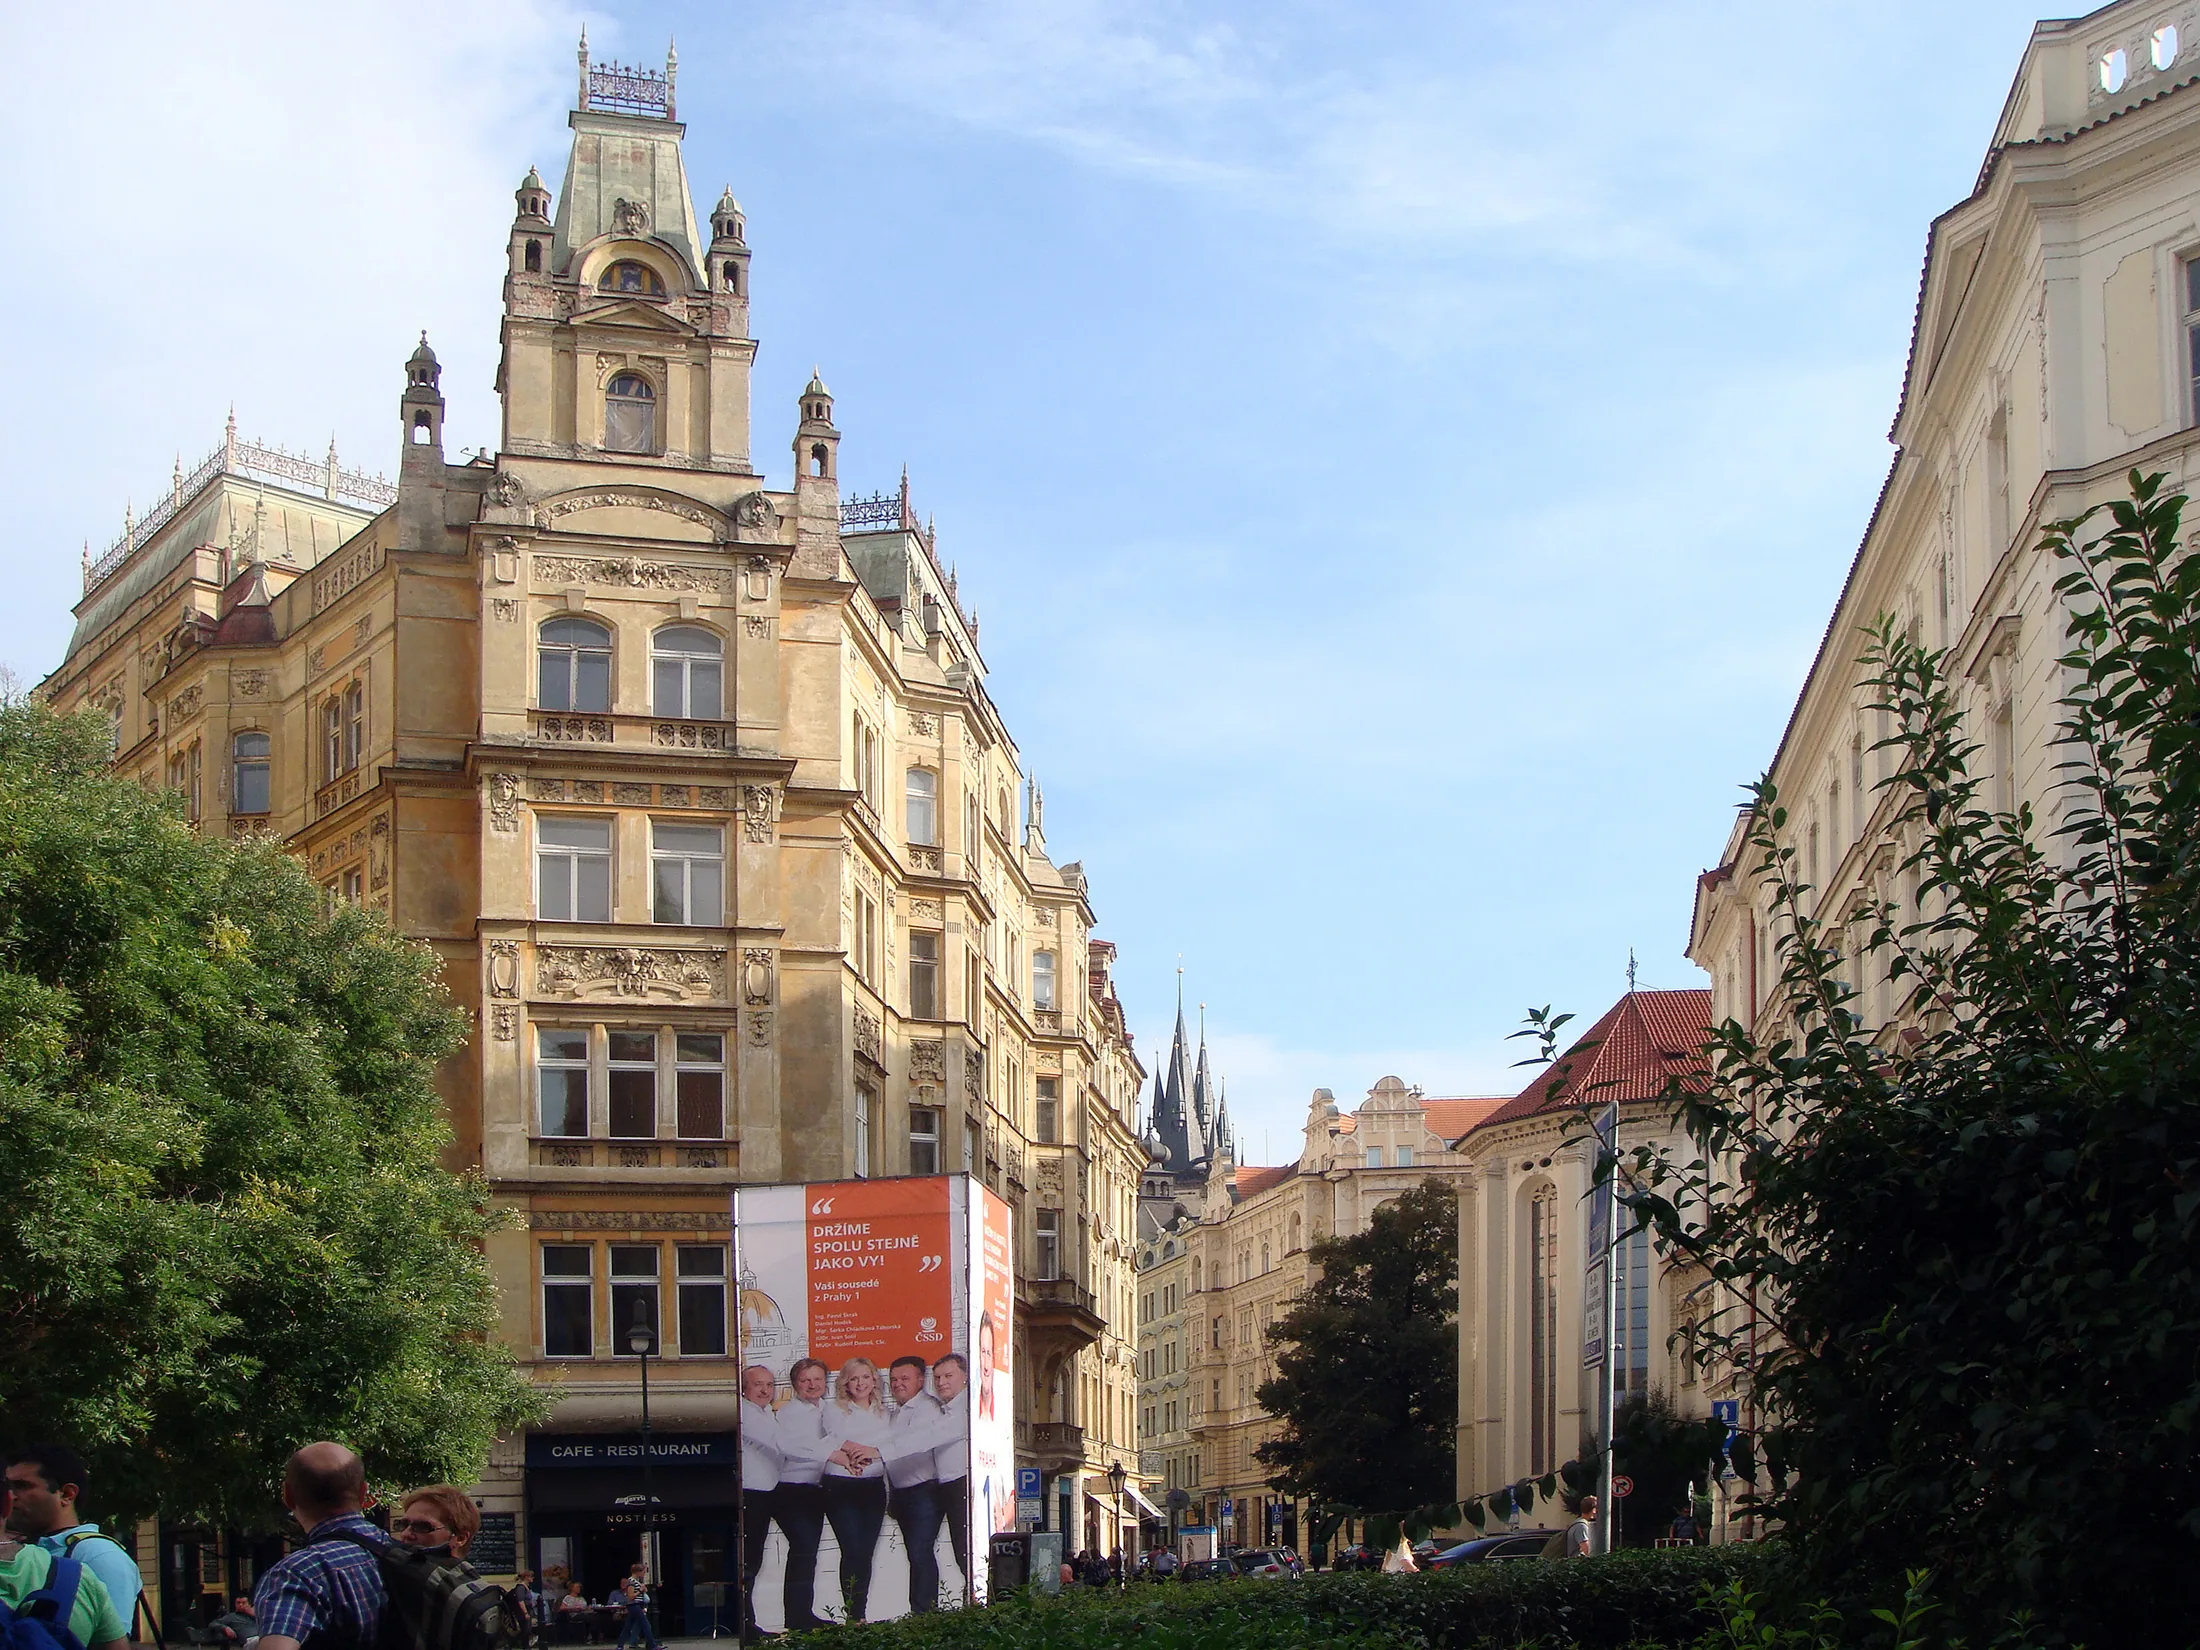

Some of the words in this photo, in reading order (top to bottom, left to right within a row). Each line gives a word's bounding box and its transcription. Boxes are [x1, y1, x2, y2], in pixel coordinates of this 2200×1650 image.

[813, 1223, 871, 1237] DRŽÍME
[814, 1240, 862, 1253] SPOLU
[867, 1235, 919, 1250] STEJNĚ
[813, 1257, 854, 1270] JAKO
[858, 1255, 885, 1268] VY!
[814, 1281, 835, 1291] Vaši
[838, 1279, 880, 1289] sousedé
[823, 1293, 852, 1303] Prahy
[855, 1292, 860, 1300] 1
[915, 1332, 944, 1343] ČSSD
[552, 1446, 594, 1457] CAFE
[607, 1444, 711, 1456] RESTAURANT
[979, 1450, 996, 1468] PRAHA
[1022, 1471, 1036, 1489] P
